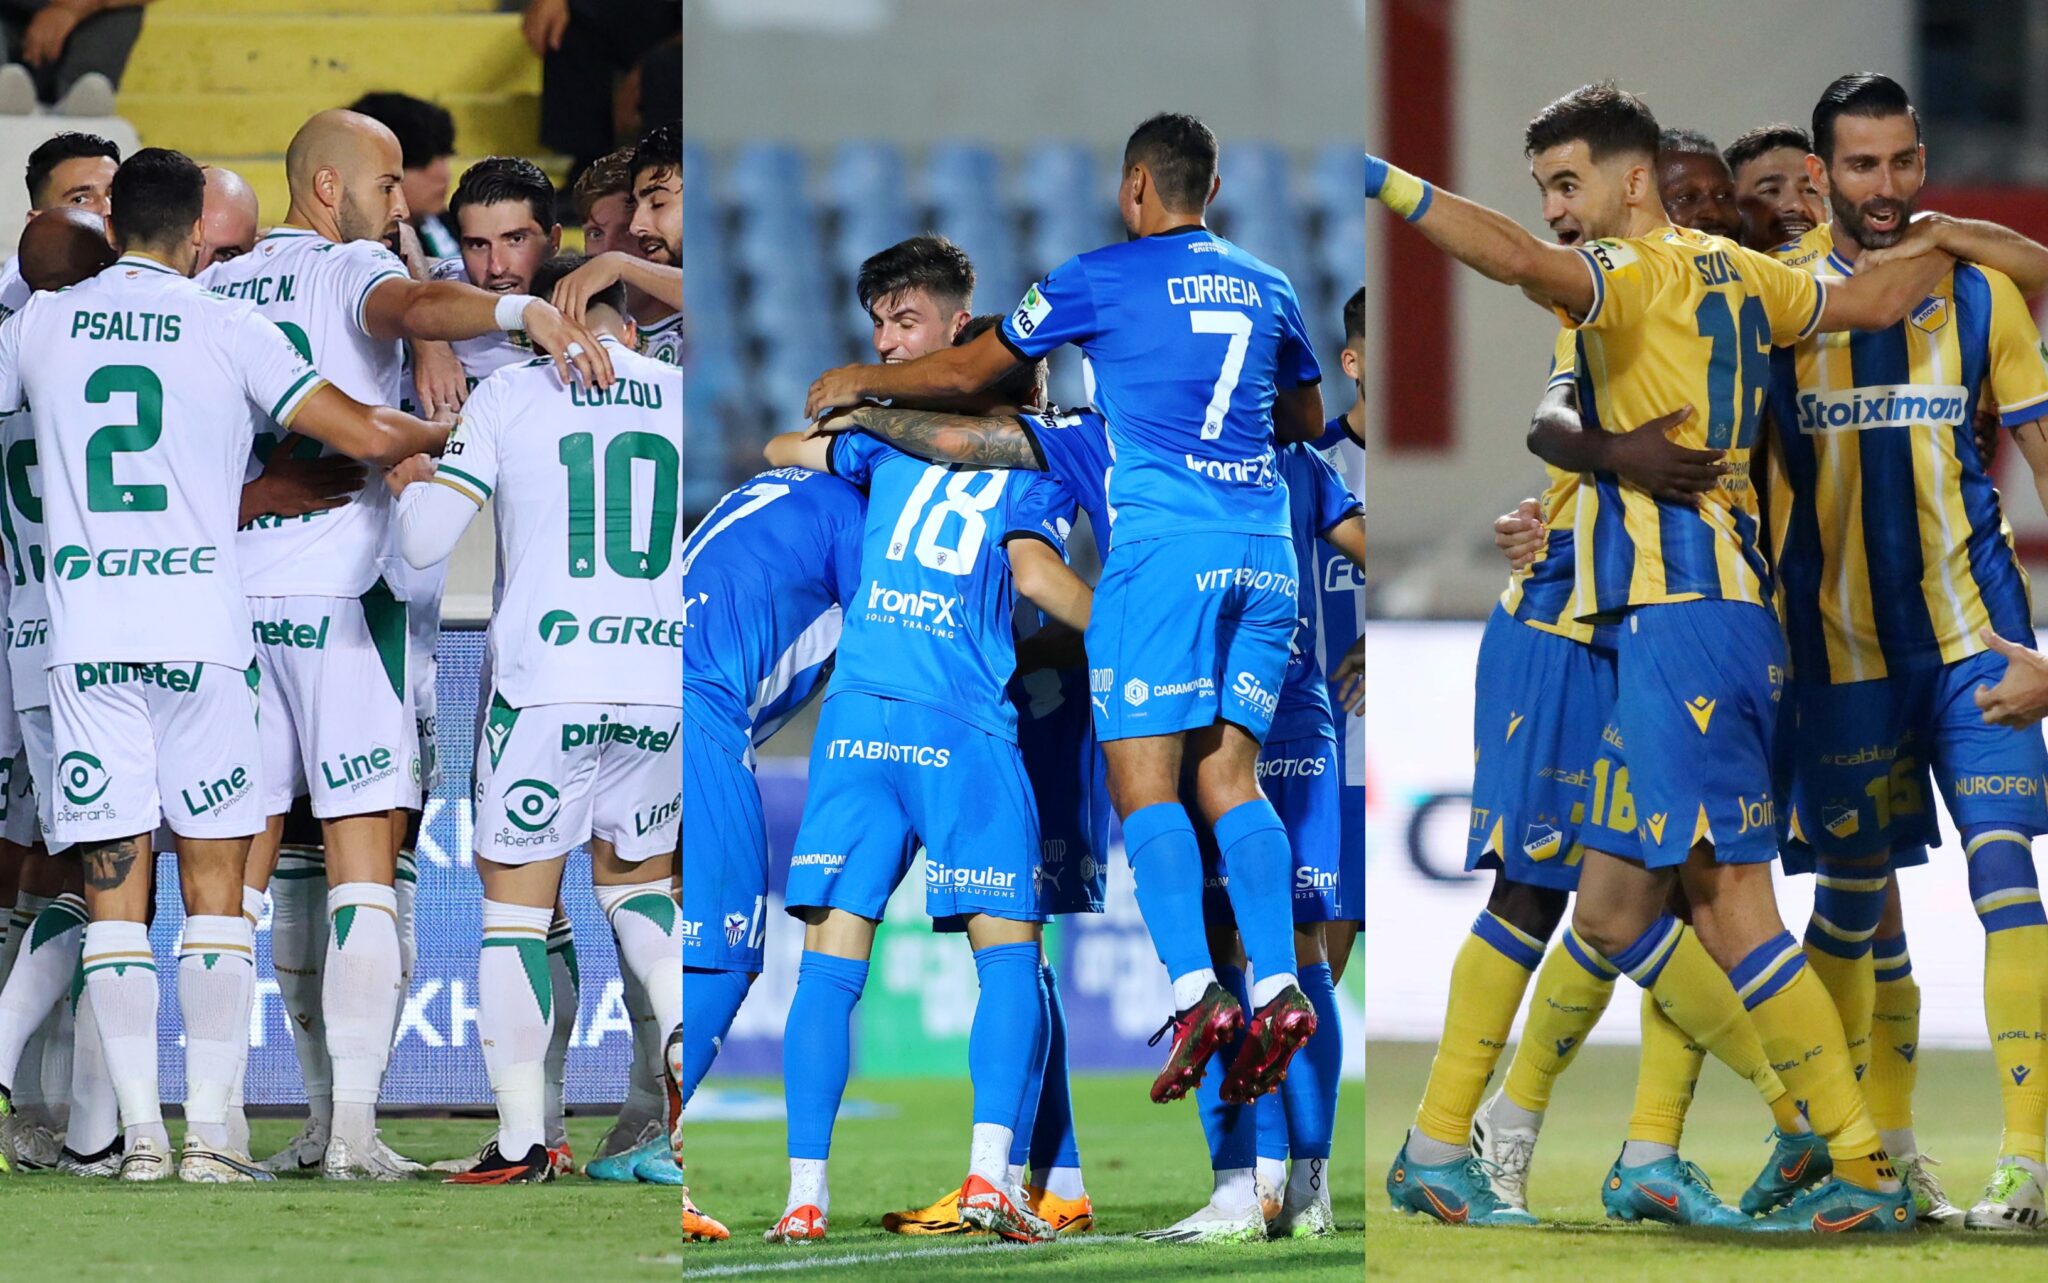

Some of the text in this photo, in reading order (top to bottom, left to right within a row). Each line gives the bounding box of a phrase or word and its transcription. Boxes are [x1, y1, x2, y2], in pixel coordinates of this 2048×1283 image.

[275, 275, 295, 302] N.
[1167, 274, 1263, 308] CORREIA
[71, 310, 182, 342] PSALTIS
[1190, 310, 1254, 440] 7
[1695, 291, 1773, 450] 16
[1799, 391, 1964, 429] Stoiximan
[84, 364, 168, 513] 2
[558, 431, 680, 579] 10
[885, 464, 1010, 576] 18
[97, 546, 217, 577] GREE
[868, 580, 957, 627] IronFX
[865, 613, 955, 640] SOLID TRADING
[321, 742, 391, 790] Line
[1955, 775, 2038, 797] NUROFEN
[181, 766, 247, 816] Line
[1591, 758, 1638, 833] 16
[635, 791, 682, 838] Line
[494, 827, 560, 848] piperaris
[926, 859, 1017, 887] Singular
[953, 886, 1016, 899] SOLUTIONS
